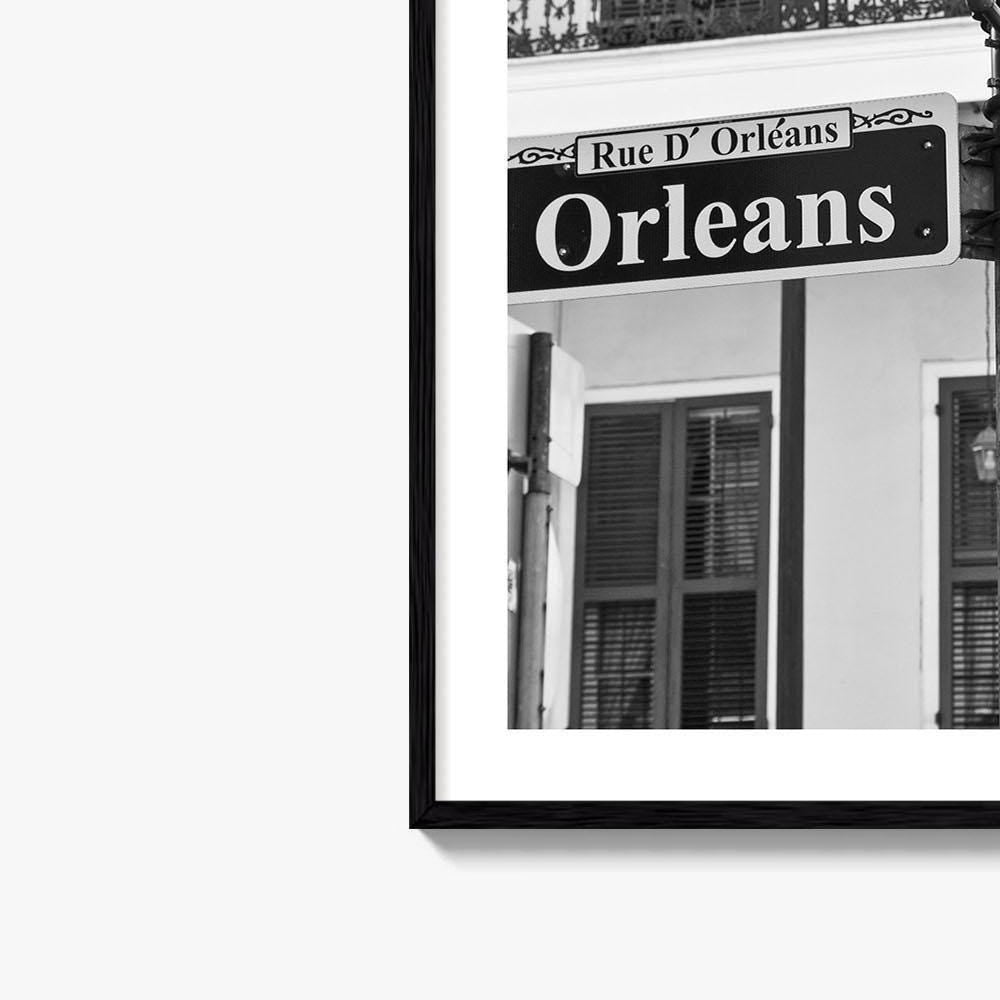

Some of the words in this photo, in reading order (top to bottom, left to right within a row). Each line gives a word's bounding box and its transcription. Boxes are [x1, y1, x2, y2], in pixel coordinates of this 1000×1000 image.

[591, 141, 654, 170] Rue
[711, 118, 839, 156] Orléans
[535, 183, 896, 272] Orleans
